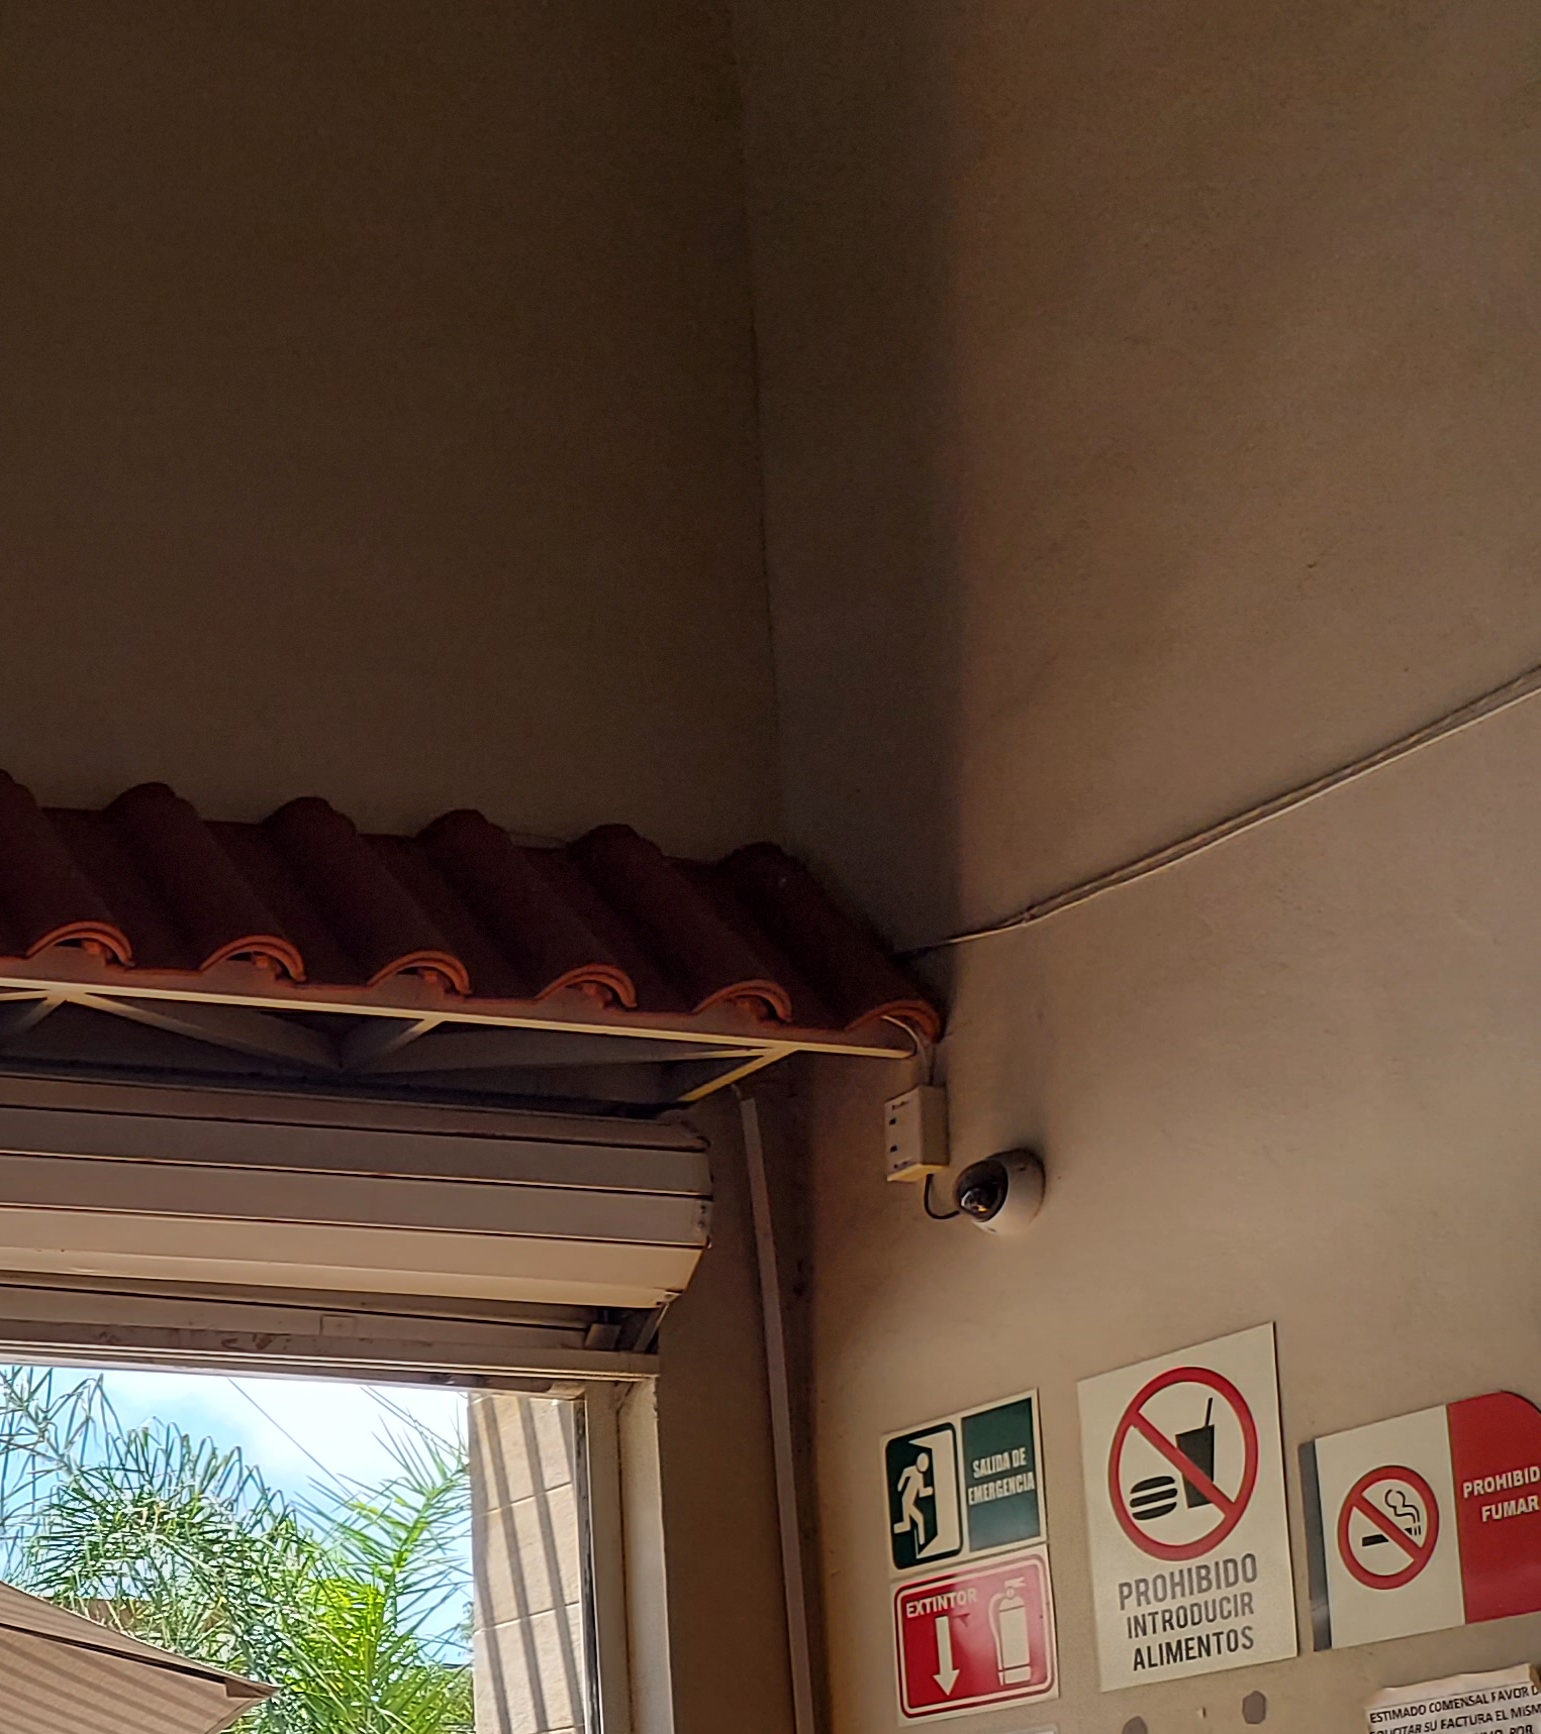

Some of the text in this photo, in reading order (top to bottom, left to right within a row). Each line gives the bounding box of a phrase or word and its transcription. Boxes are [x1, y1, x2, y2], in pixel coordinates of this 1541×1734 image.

[972, 1447, 1027, 1479] SALIDA DE
[968, 1471, 1036, 1506] EMERGENCIA
[1481, 1495, 1539, 1522] FUMAR
[1118, 1553, 1258, 1611] PROHIBIDO
[906, 1587, 977, 1619] EXTINTOR
[1126, 1591, 1254, 1639] INTRODUCIR
[1133, 1625, 1254, 1671] ALIMENTOS
[1370, 1704, 1427, 1724] ESTIMADO
[1429, 1694, 1490, 1713] COMENSAL
[1491, 1685, 1529, 1703] FAVOR
[1424, 1720, 1438, 1732] SU
[1441, 1712, 1493, 1730] FACTURA
[1496, 1710, 1509, 1722] EL
